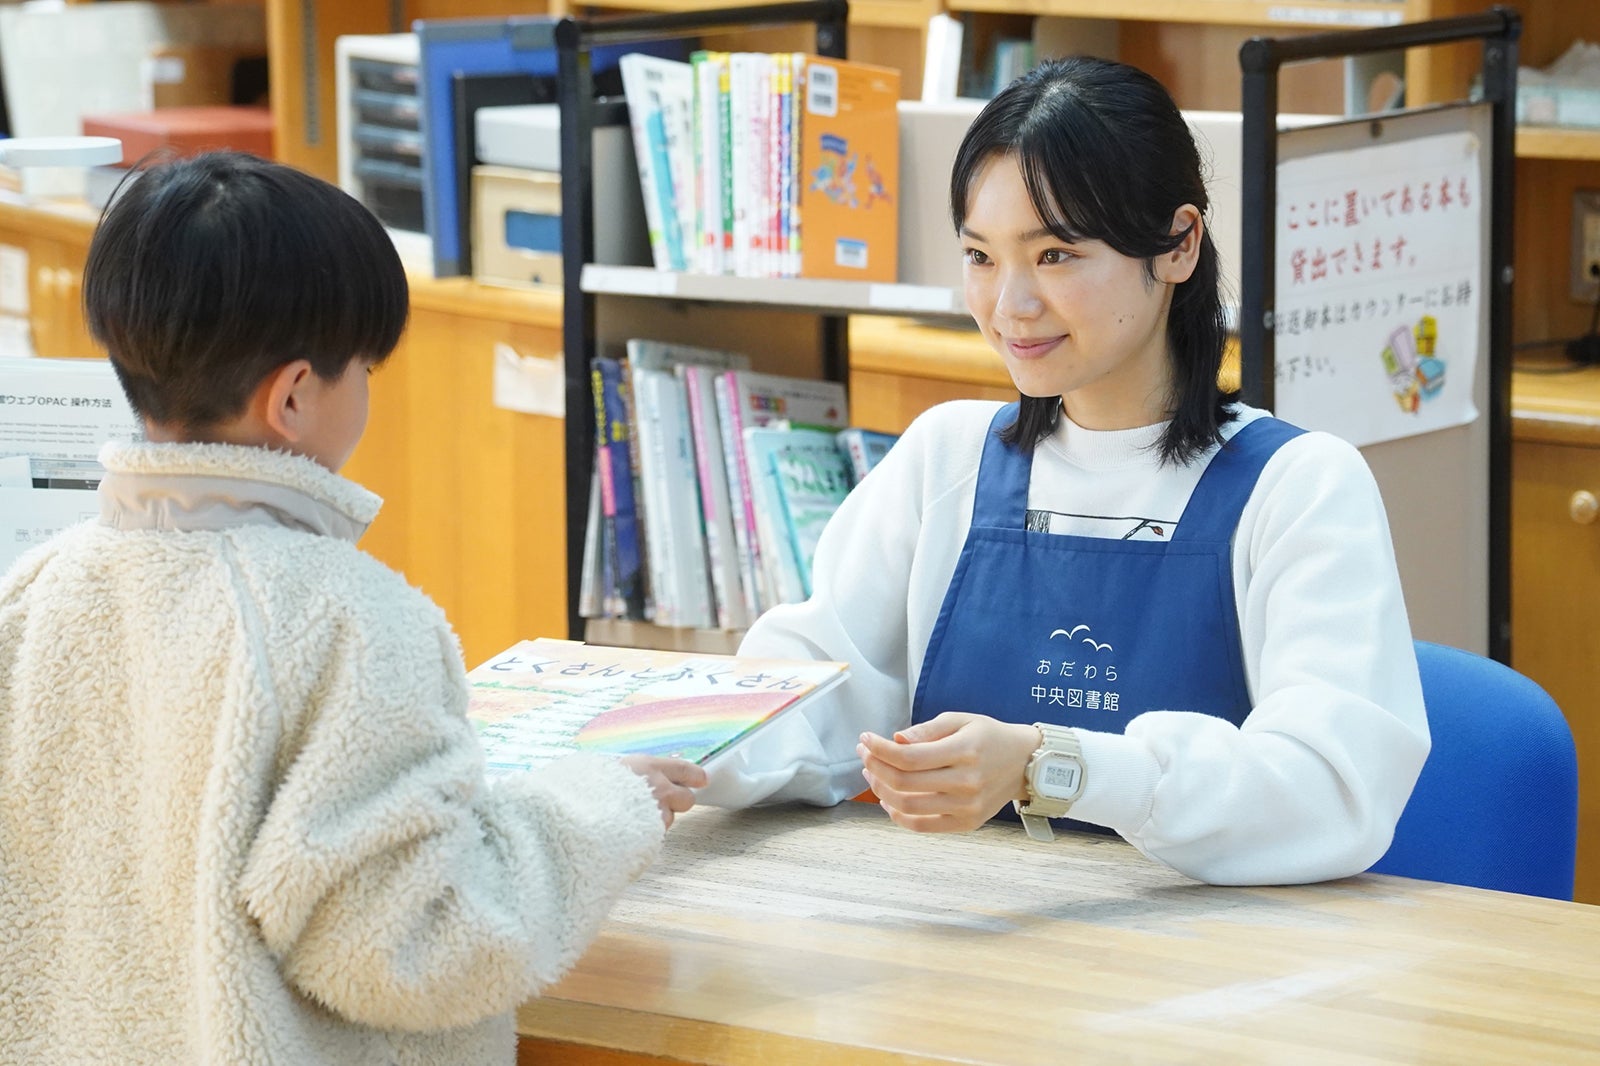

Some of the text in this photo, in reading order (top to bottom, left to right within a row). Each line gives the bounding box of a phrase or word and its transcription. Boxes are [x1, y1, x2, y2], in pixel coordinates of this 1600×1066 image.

[1288, 177, 1471, 229] ここに置いてある本も
[1291, 235, 1416, 285] 貸出できます。
[71, 397, 112, 408] 操作方法
[490, 656, 803, 691] とくさんとふくさん
[1036, 659, 1118, 681] おだわら
[1031, 684, 1120, 711] 中央図書館
